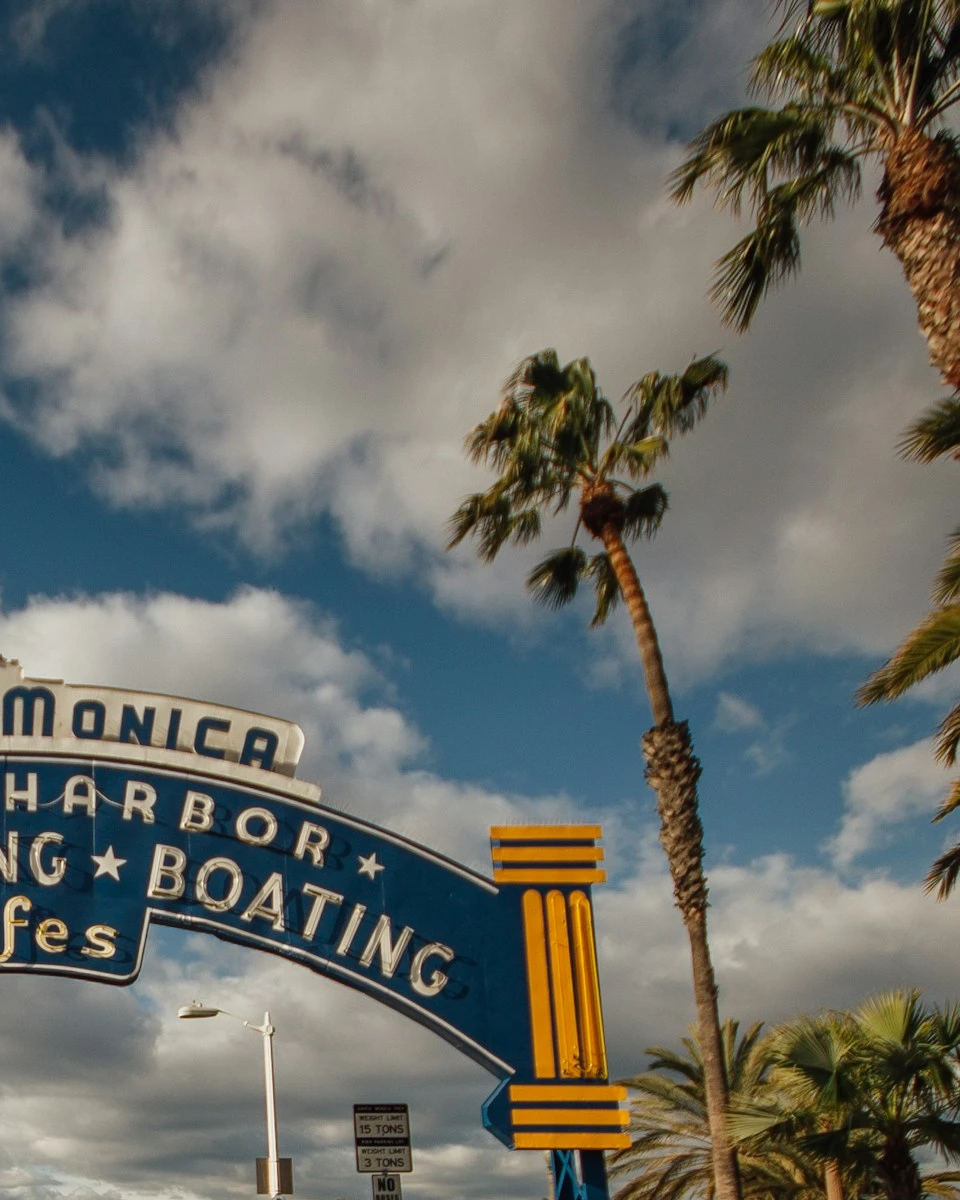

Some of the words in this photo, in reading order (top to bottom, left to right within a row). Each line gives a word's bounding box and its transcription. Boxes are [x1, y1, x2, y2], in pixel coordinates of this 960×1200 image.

[2, 685, 280, 771] MONICA
[4, 771, 332, 868] HARBOR
[146, 843, 456, 998] BOATING
[360, 1124, 372, 1134] 15
[375, 1124, 405, 1134] TONS
[364, 1158, 372, 1167] 3
[376, 1158, 405, 1167] TONS
[378, 1178, 396, 1191] NO
